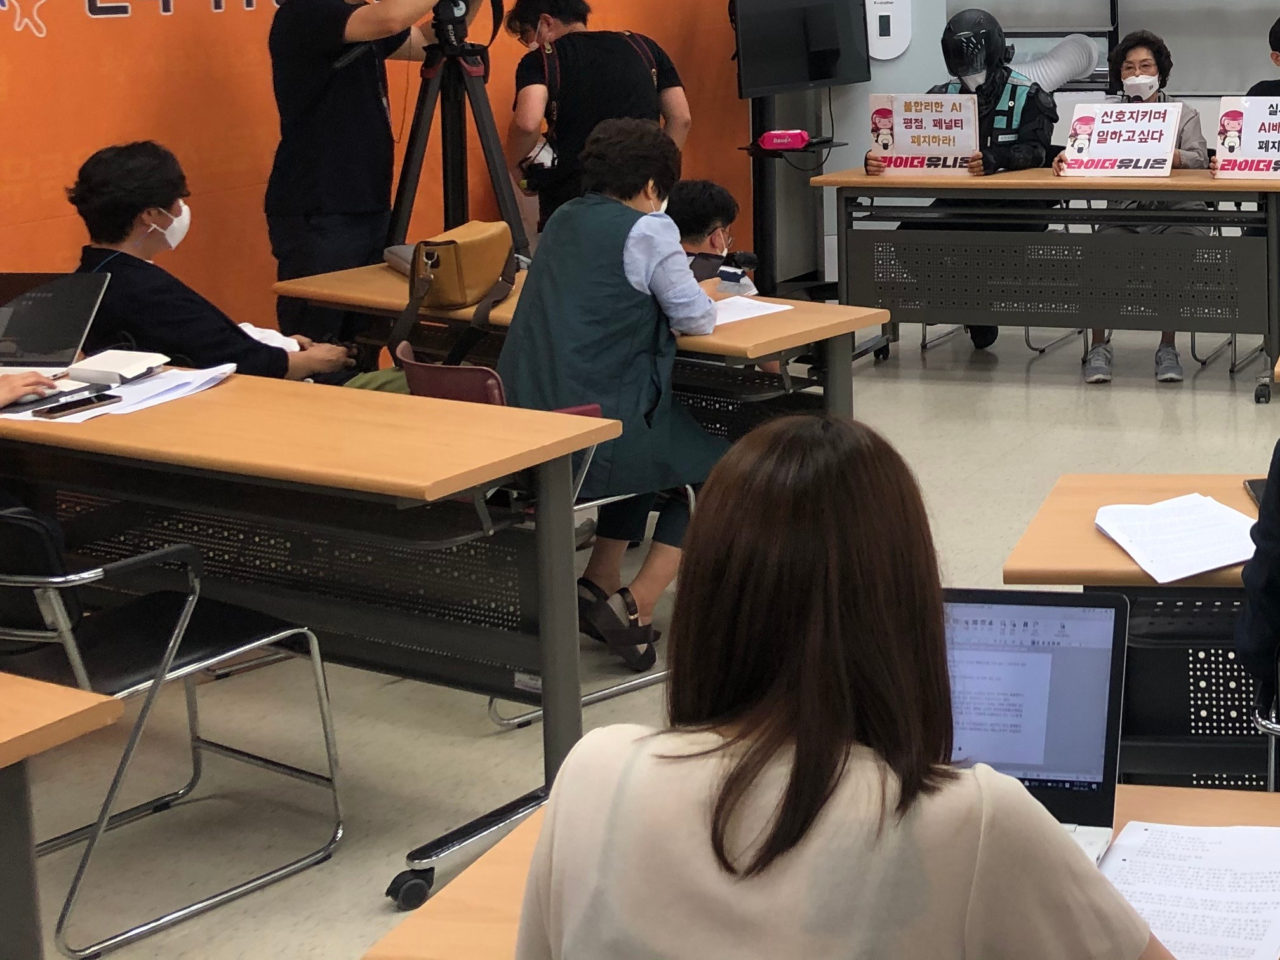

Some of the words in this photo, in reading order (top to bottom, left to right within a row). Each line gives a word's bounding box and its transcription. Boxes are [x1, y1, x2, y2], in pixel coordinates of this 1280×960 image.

[904, 101, 944, 113] 불합리한
[951, 102, 962, 113] AI
[1101, 109, 1167, 124] 신호지키며
[932, 118, 964, 130] 페널티
[1096, 129, 1164, 145] 일하고싶다
[1066, 158, 1168, 170] 라이더유니온
